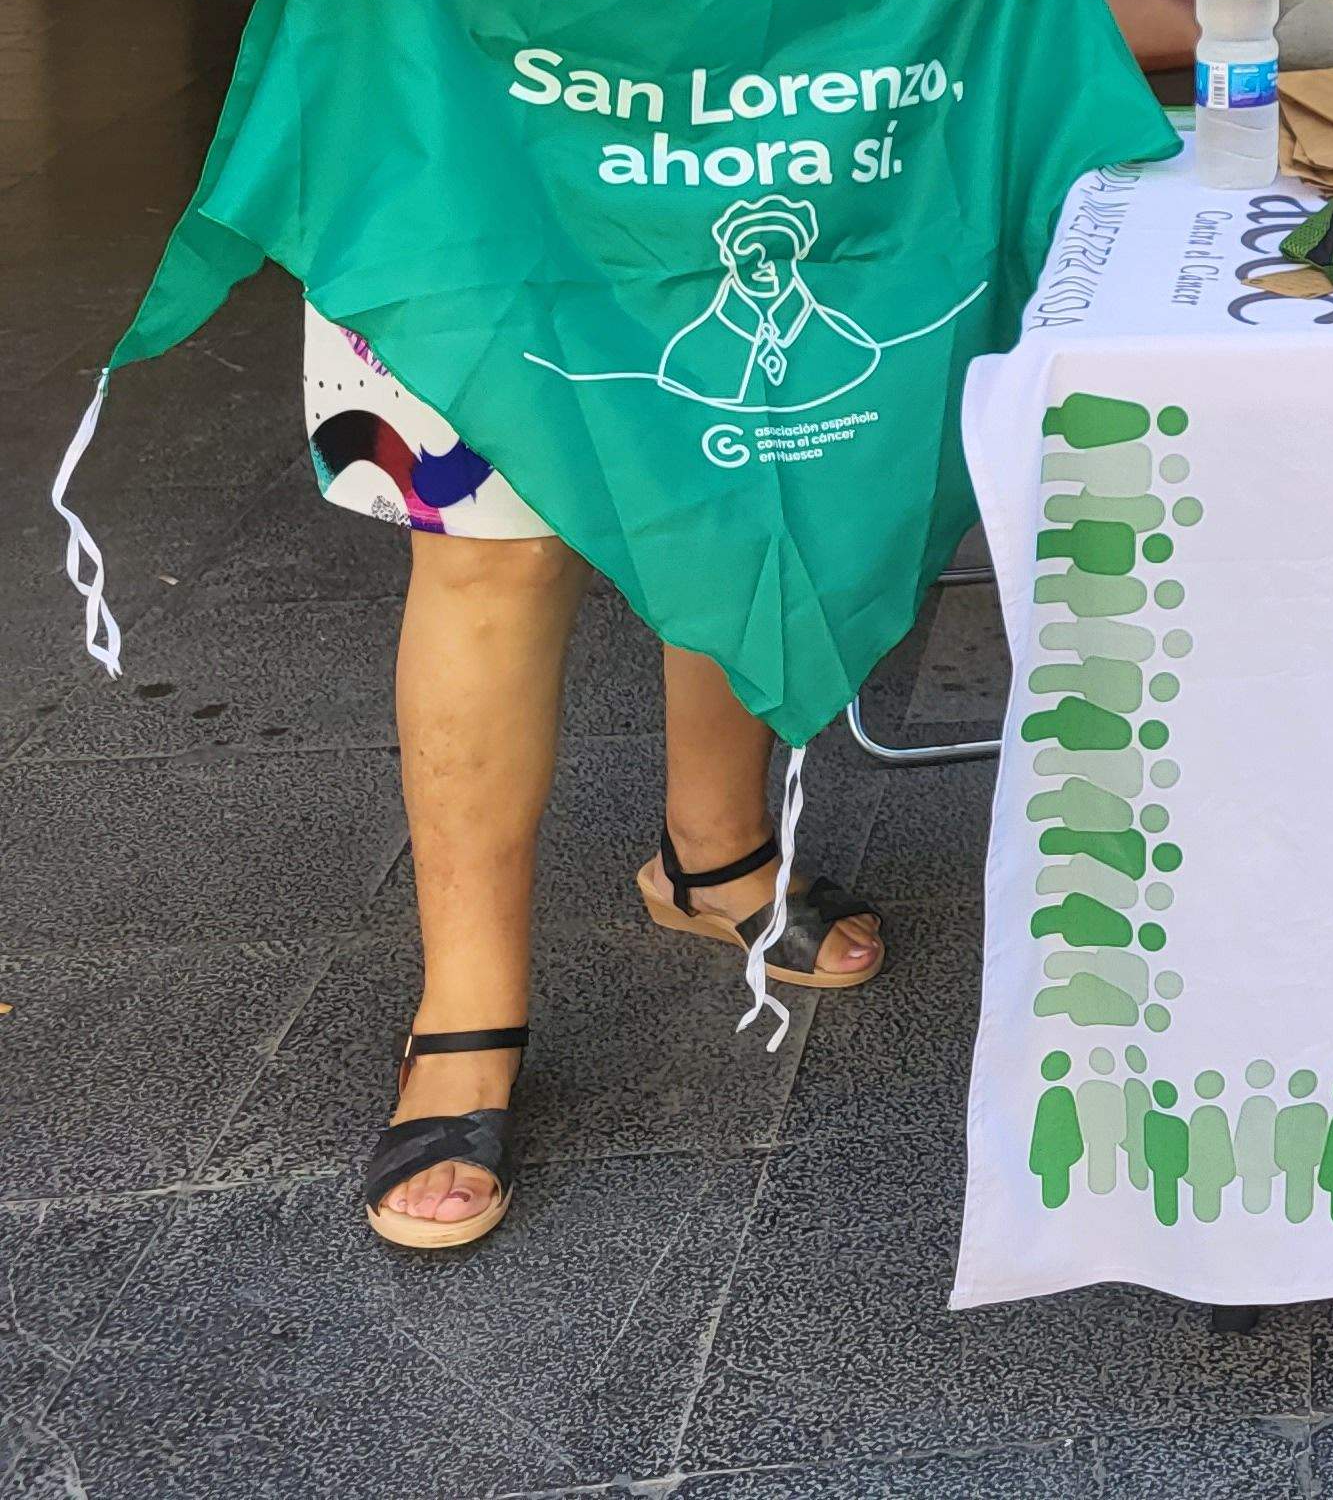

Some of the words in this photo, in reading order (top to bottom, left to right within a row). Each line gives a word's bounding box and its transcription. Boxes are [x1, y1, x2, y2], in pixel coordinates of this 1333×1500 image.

[508, 48, 666, 124] San
[691, 60, 965, 127] Lorenzo,
[599, 132, 834, 187] ahora
[852, 120, 902, 183] sí.
[1054, 195, 1131, 275] NUESTRA
[1184, 210, 1234, 246] Contra
[1183, 250, 1225, 259] el
[1026, 275, 1098, 332] VIDA
[1171, 264, 1220, 306] Cáncer
[754, 424, 819, 437] asociación
[820, 411, 879, 431] española
[757, 438, 795, 450] contra
[797, 435, 809, 449] el
[811, 429, 856, 445] cáncer
[759, 451, 776, 463] en
[777, 448, 823, 463] Huesca
